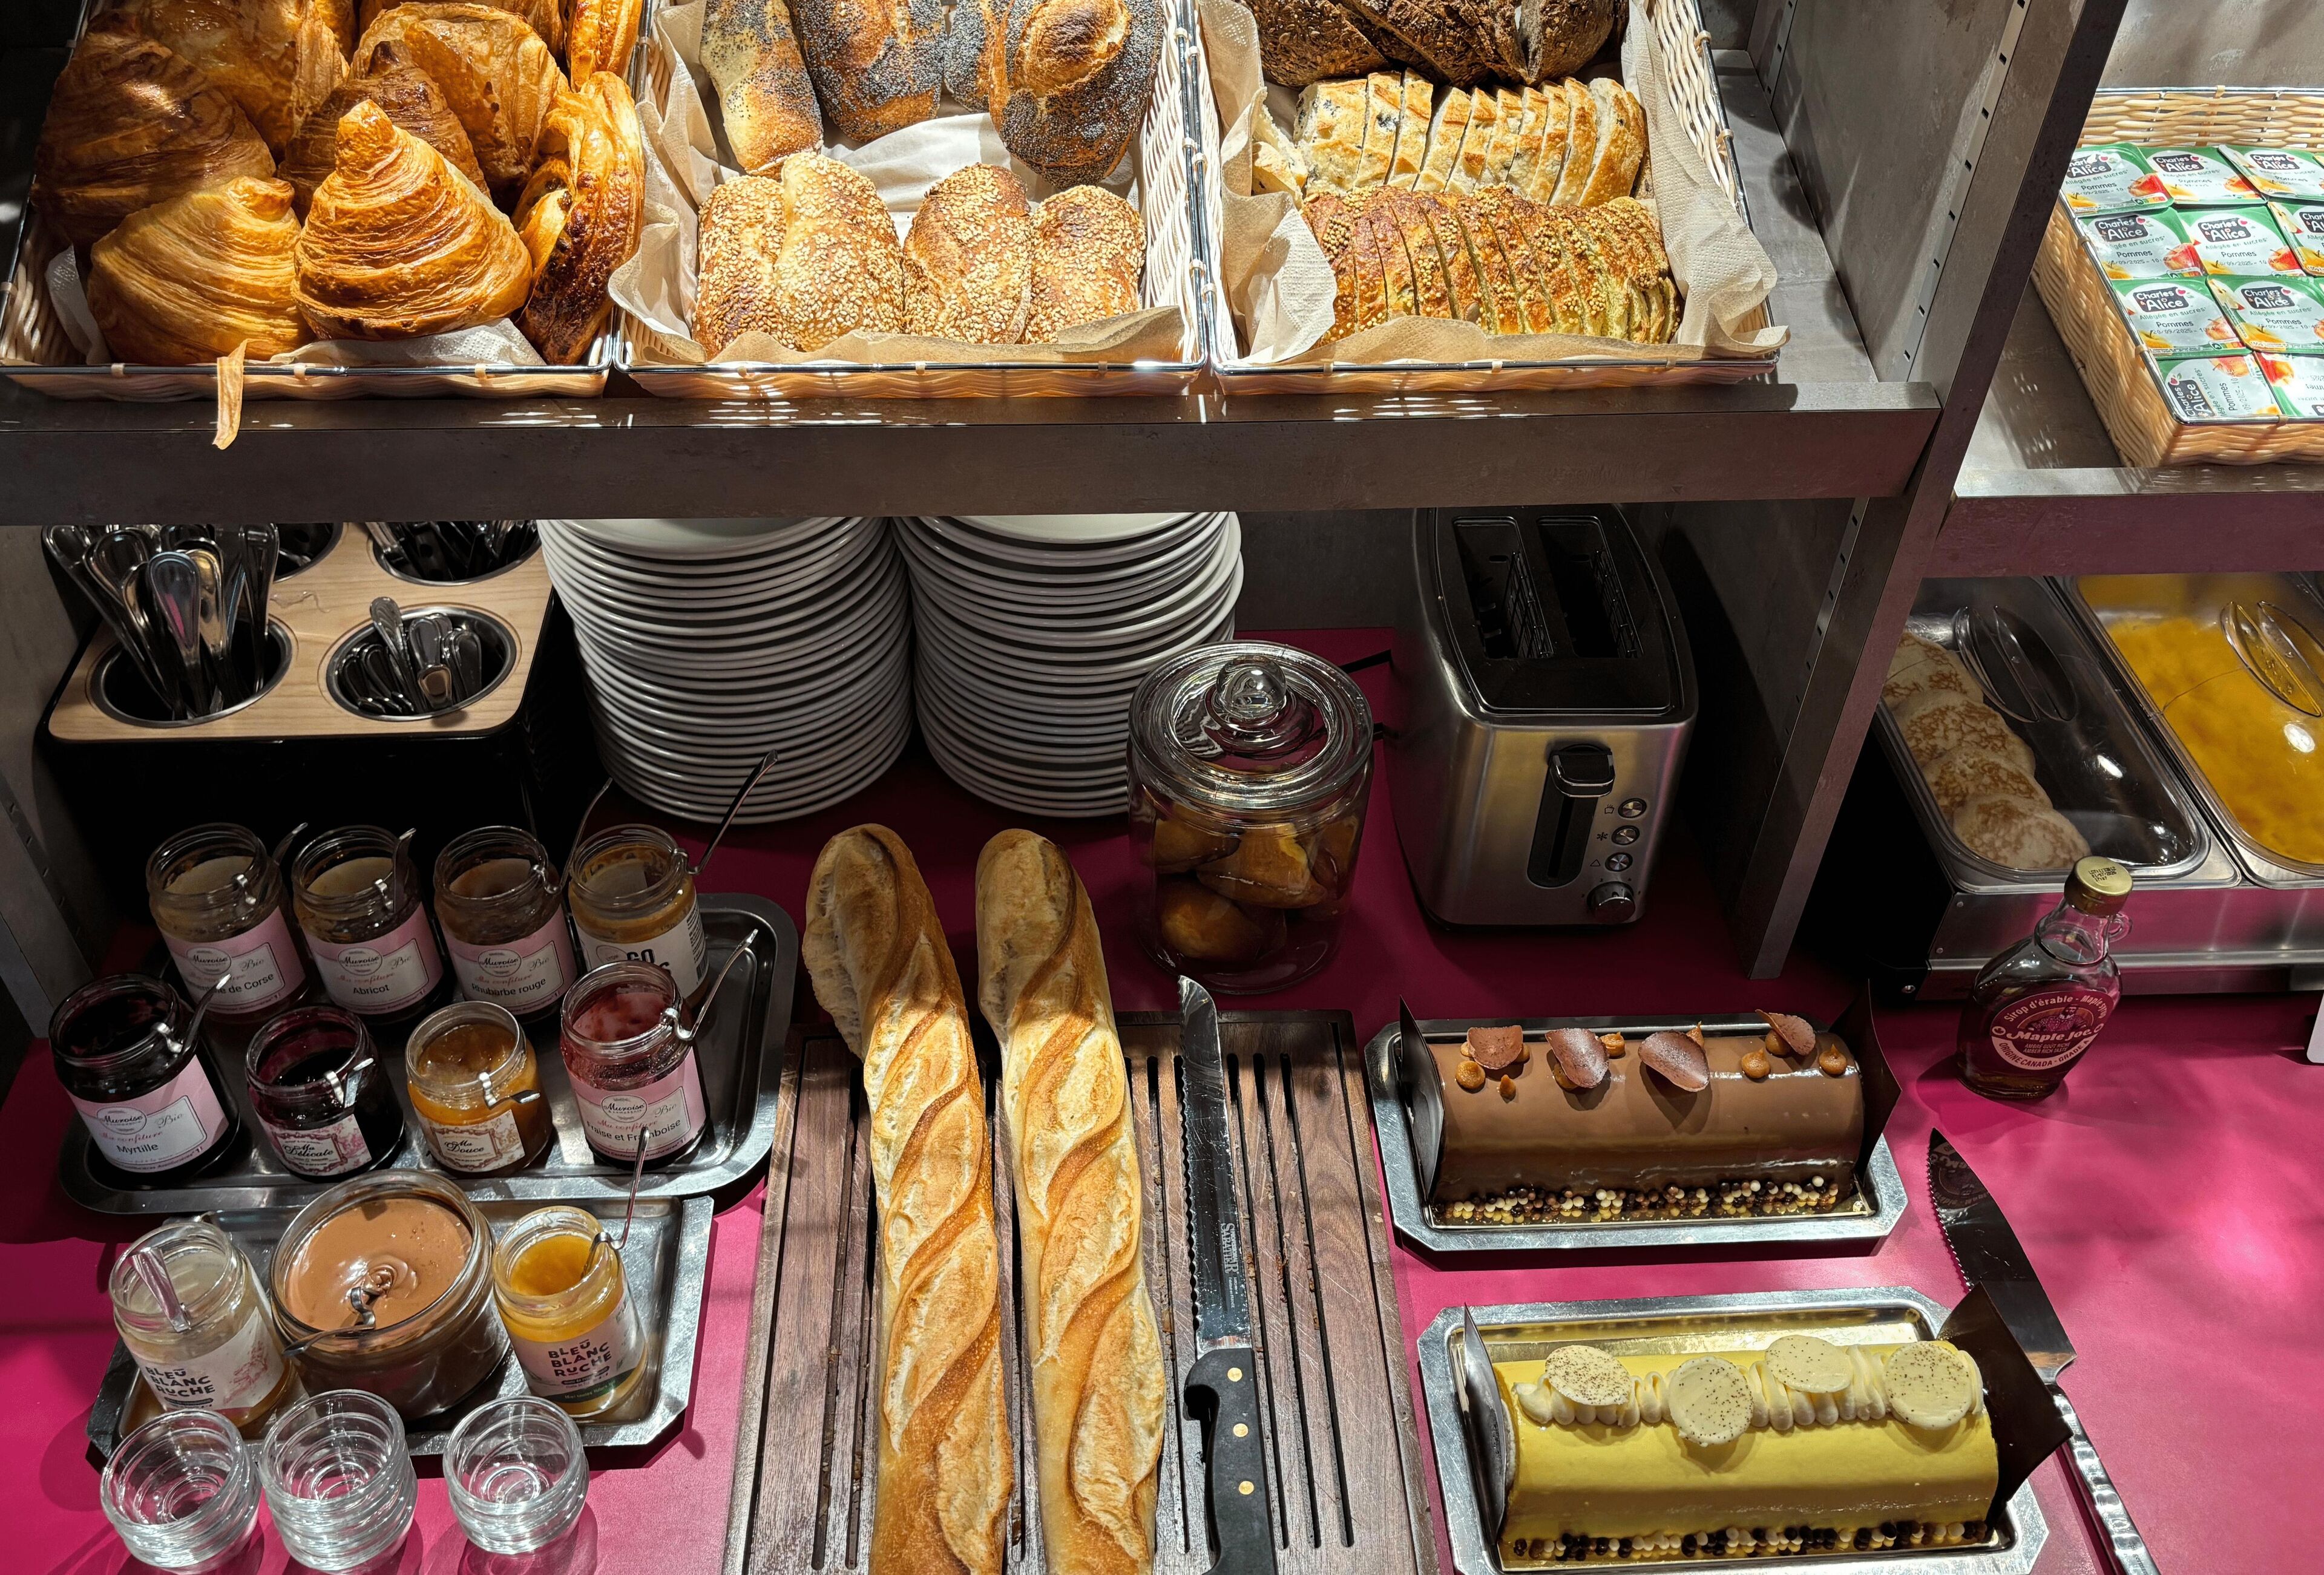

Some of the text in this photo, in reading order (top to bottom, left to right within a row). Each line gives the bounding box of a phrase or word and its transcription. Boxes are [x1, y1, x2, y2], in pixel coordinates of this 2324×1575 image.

[2071, 165, 2107, 177] Alice
[2166, 162, 2199, 172] Alice
[2263, 160, 2296, 169] Alice
[2081, 182, 2117, 191] Pommes
[2098, 218, 2135, 229] Charles
[2201, 220, 2237, 230] Charles
[2107, 227, 2144, 241] Alice
[2210, 228, 2247, 241] Alice
[2136, 289, 2174, 301] Charles
[2244, 289, 2280, 297] Charles
[2145, 298, 2184, 311] Alice
[2254, 296, 2290, 308] Alice
[2139, 312, 2167, 321] Allégée
[2175, 387, 2196, 416] Charles
[2187, 384, 2212, 413] Alice
[2219, 382, 2238, 411] Pommes
[228, 985, 242, 994] de
[244, 973, 274, 991] Corse
[353, 984, 390, 995] Abricot
[471, 977, 547, 997] Rhubarbe rouge
[2004, 1006, 2029, 1023] Sirop
[2029, 995, 2073, 1010] d'érable
[2079, 995, 2101, 1007] Maple
[2006, 1028, 2092, 1043] Maple Joe
[1999, 1042, 2023, 1063] ORIGINE
[2020, 1058, 2053, 1067] CANADA
[2058, 1046, 2084, 1063] GRADE
[606, 1102, 645, 1112] Muroise
[654, 1103, 677, 1118] Bio
[586, 1121, 612, 1139] Fraise
[116, 1143, 159, 1155] Myrtille
[444, 1141, 485, 1153] Douce
[1220, 1222, 1239, 1274] SABATIER
[551, 1341, 609, 1367] BLANC
[554, 1351, 612, 1377] RUCHE
[150, 1375, 211, 1386] BLANC
[155, 1384, 215, 1397] RUCHE
